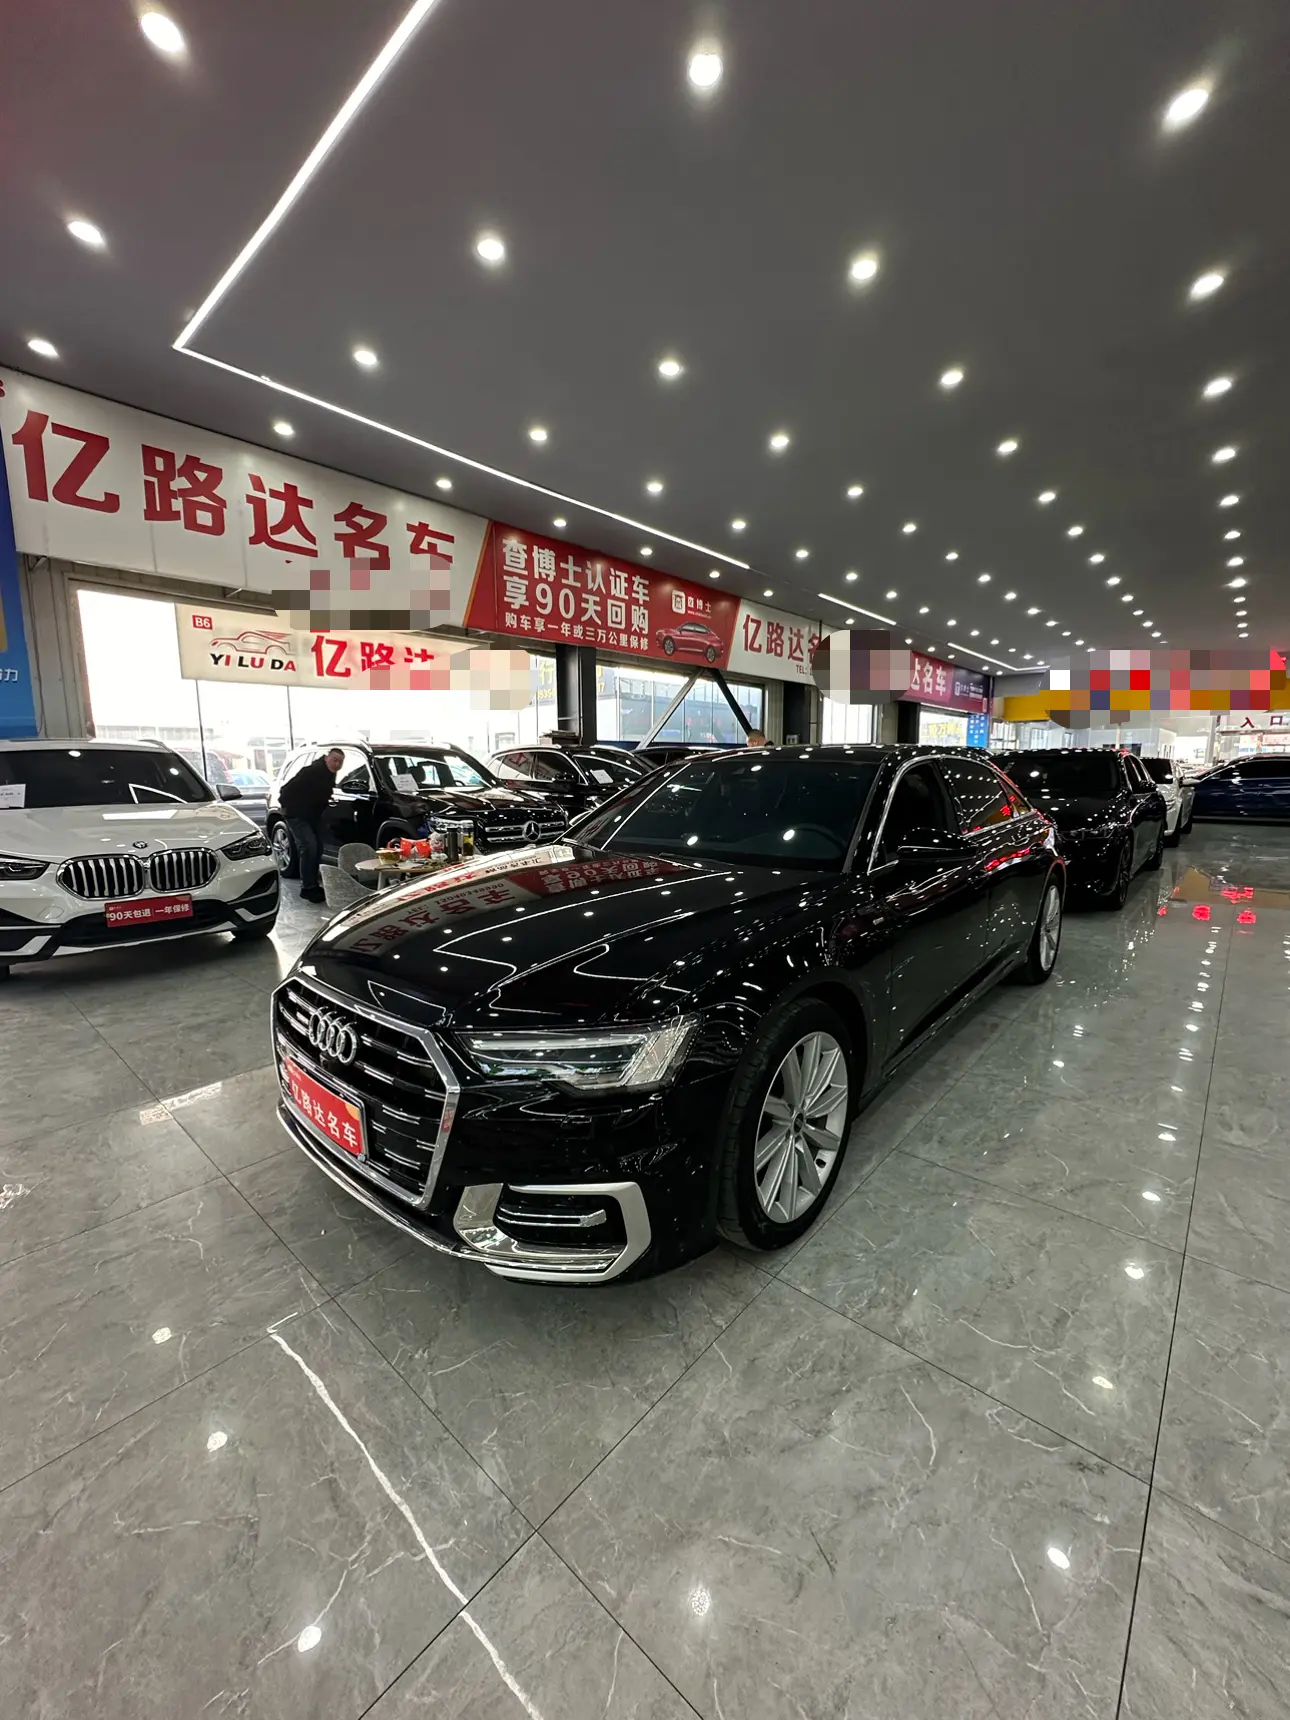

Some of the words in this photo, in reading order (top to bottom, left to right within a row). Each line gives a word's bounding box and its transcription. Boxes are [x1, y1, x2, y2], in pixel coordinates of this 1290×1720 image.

[502, 538, 650, 604] 查博士认证车
[503, 575, 649, 634] 享90天回购
[195, 616, 211, 629] B6
[505, 612, 649, 650] 购车享一年或三万公里保修
[210, 653, 231, 667] YI
[238, 656, 264, 669] LU
[270, 659, 297, 672] DA
[0, 668, 18, 681] 力
[109, 908, 152, 922] 90天包退
[155, 903, 190, 914] 一年保修
